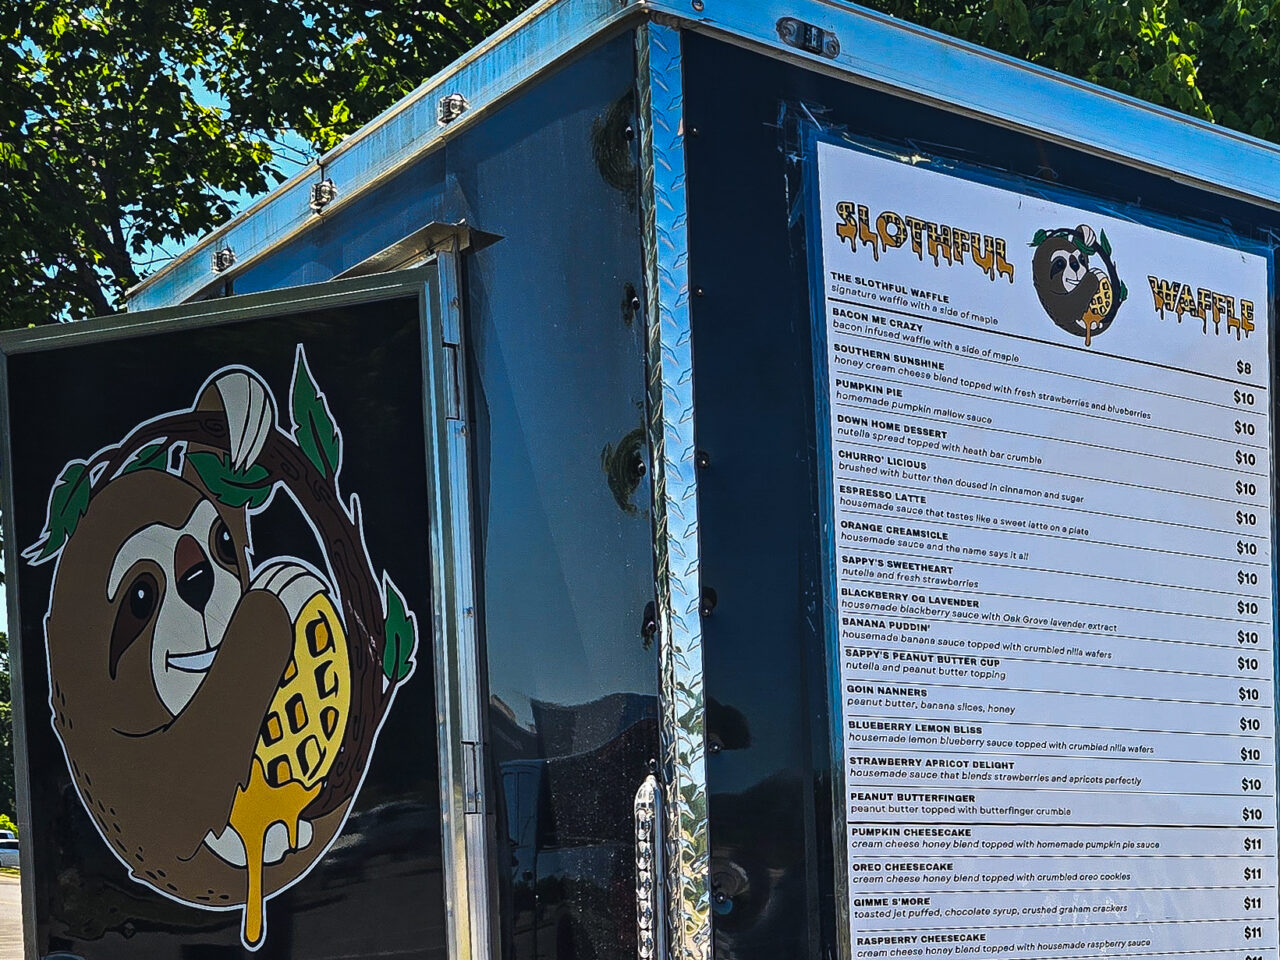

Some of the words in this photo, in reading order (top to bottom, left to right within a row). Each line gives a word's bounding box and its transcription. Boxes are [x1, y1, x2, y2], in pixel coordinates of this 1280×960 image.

[836, 201, 1014, 284] SLOTHFUL
[829, 270, 852, 284] THE
[854, 276, 908, 295] SLOTHFUL
[909, 287, 950, 304] WAFFLE
[830, 283, 878, 301] signature
[878, 291, 909, 307] waffle
[909, 299, 931, 312] with
[931, 305, 938, 313] a
[938, 305, 959, 317] side
[959, 310, 970, 320] of
[970, 313, 999, 326] maple
[1147, 275, 1255, 341] WAFFLE
[831, 306, 869, 322] BACON
[871, 314, 887, 326] ME
[888, 318, 923, 333] CRAZY
[833, 342, 891, 361] SOUTHERN
[892, 353, 945, 371] SUNSHINE
[1236, 358, 1252, 375] $8
[834, 377, 884, 395] PUMPKIN
[885, 386, 903, 398] PIE
[1232, 388, 1255, 406] $10
[835, 389, 890, 407] homemade
[890, 400, 932, 415] pumpkin
[932, 408, 966, 420] mallow
[965, 413, 993, 425] sauce
[836, 413, 869, 427] DOWN
[870, 419, 901, 432] HOME
[903, 424, 948, 440] DESSERT
[1233, 418, 1256, 436] $10
[837, 449, 885, 464] CHURRO'
[886, 455, 927, 471] LICIOUS
[1234, 448, 1256, 467] $10
[838, 484, 892, 500] ESPRESSO
[894, 492, 927, 505] LATTE
[1234, 479, 1257, 496] $10
[1235, 509, 1257, 526] $10
[839, 519, 883, 533] ORANGE
[885, 525, 949, 541] CREAMSICLE
[1235, 539, 1258, 556] $10
[841, 554, 885, 568] SAPPY'S
[886, 559, 954, 575] SWEETHEART
[841, 567, 875, 578] nutella
[875, 570, 895, 580] and
[896, 571, 921, 583] fresh
[921, 575, 979, 589] strawberries
[1236, 569, 1258, 586] $10
[840, 587, 909, 602] BLACKBERRY
[927, 595, 980, 609] LAVENDER
[1236, 599, 1259, 615] $10
[841, 616, 886, 629] BANANA
[888, 620, 931, 632] PUDDIN'
[1236, 628, 1259, 645] $10
[844, 647, 890, 660] SAPPY'S
[891, 651, 934, 663] PEANUT
[936, 654, 978, 666] BUTTER
[979, 657, 1000, 668] CUP
[1236, 655, 1259, 671] $10
[845, 660, 880, 671] nutella
[881, 663, 901, 673] and
[901, 665, 937, 677] peanut
[937, 666, 968, 677] butter
[969, 669, 1006, 681] topping
[846, 684, 874, 695] GOIN
[876, 685, 928, 698] NANNERS
[1237, 685, 1259, 702] $10
[846, 697, 883, 709] peanut
[883, 698, 919, 710] butter,
[919, 699, 955, 711] banana
[956, 701, 986, 713] slices,
[986, 703, 1016, 716] honey
[847, 719, 912, 732] BLUEBERRY
[914, 723, 951, 733] LEMON
[952, 724, 983, 735] BLISS
[1239, 716, 1261, 732] $10
[1239, 746, 1261, 762] $10
[848, 756, 922, 767] STRAWBERRY
[924, 758, 970, 768] APRICOT
[971, 760, 1015, 770] DELIGHT
[1240, 776, 1262, 792] $10
[849, 791, 894, 801] PEANUT
[896, 792, 976, 803] BUTTERFINGER
[850, 804, 886, 817] peanut
[887, 803, 919, 814] butter
[920, 805, 956, 816] topped
[956, 804, 978, 815] with
[978, 805, 1035, 817] butterfinger
[1035, 806, 1071, 816] crumble
[1241, 806, 1263, 822] $10
[851, 827, 901, 837] PUMPKIN
[903, 827, 972, 837] CHEESECAKE
[1243, 835, 1262, 852] $11
[851, 862, 882, 872] OREO
[884, 862, 954, 872] CHEESECAKE
[1243, 865, 1262, 882] $11
[853, 897, 889, 907] GIMME
[891, 896, 931, 906] S'MORE
[1243, 895, 1262, 911] $11
[856, 935, 918, 946] RASPBERRY
[920, 932, 986, 944] CHEESECAKE
[1243, 924, 1262, 941] $11
